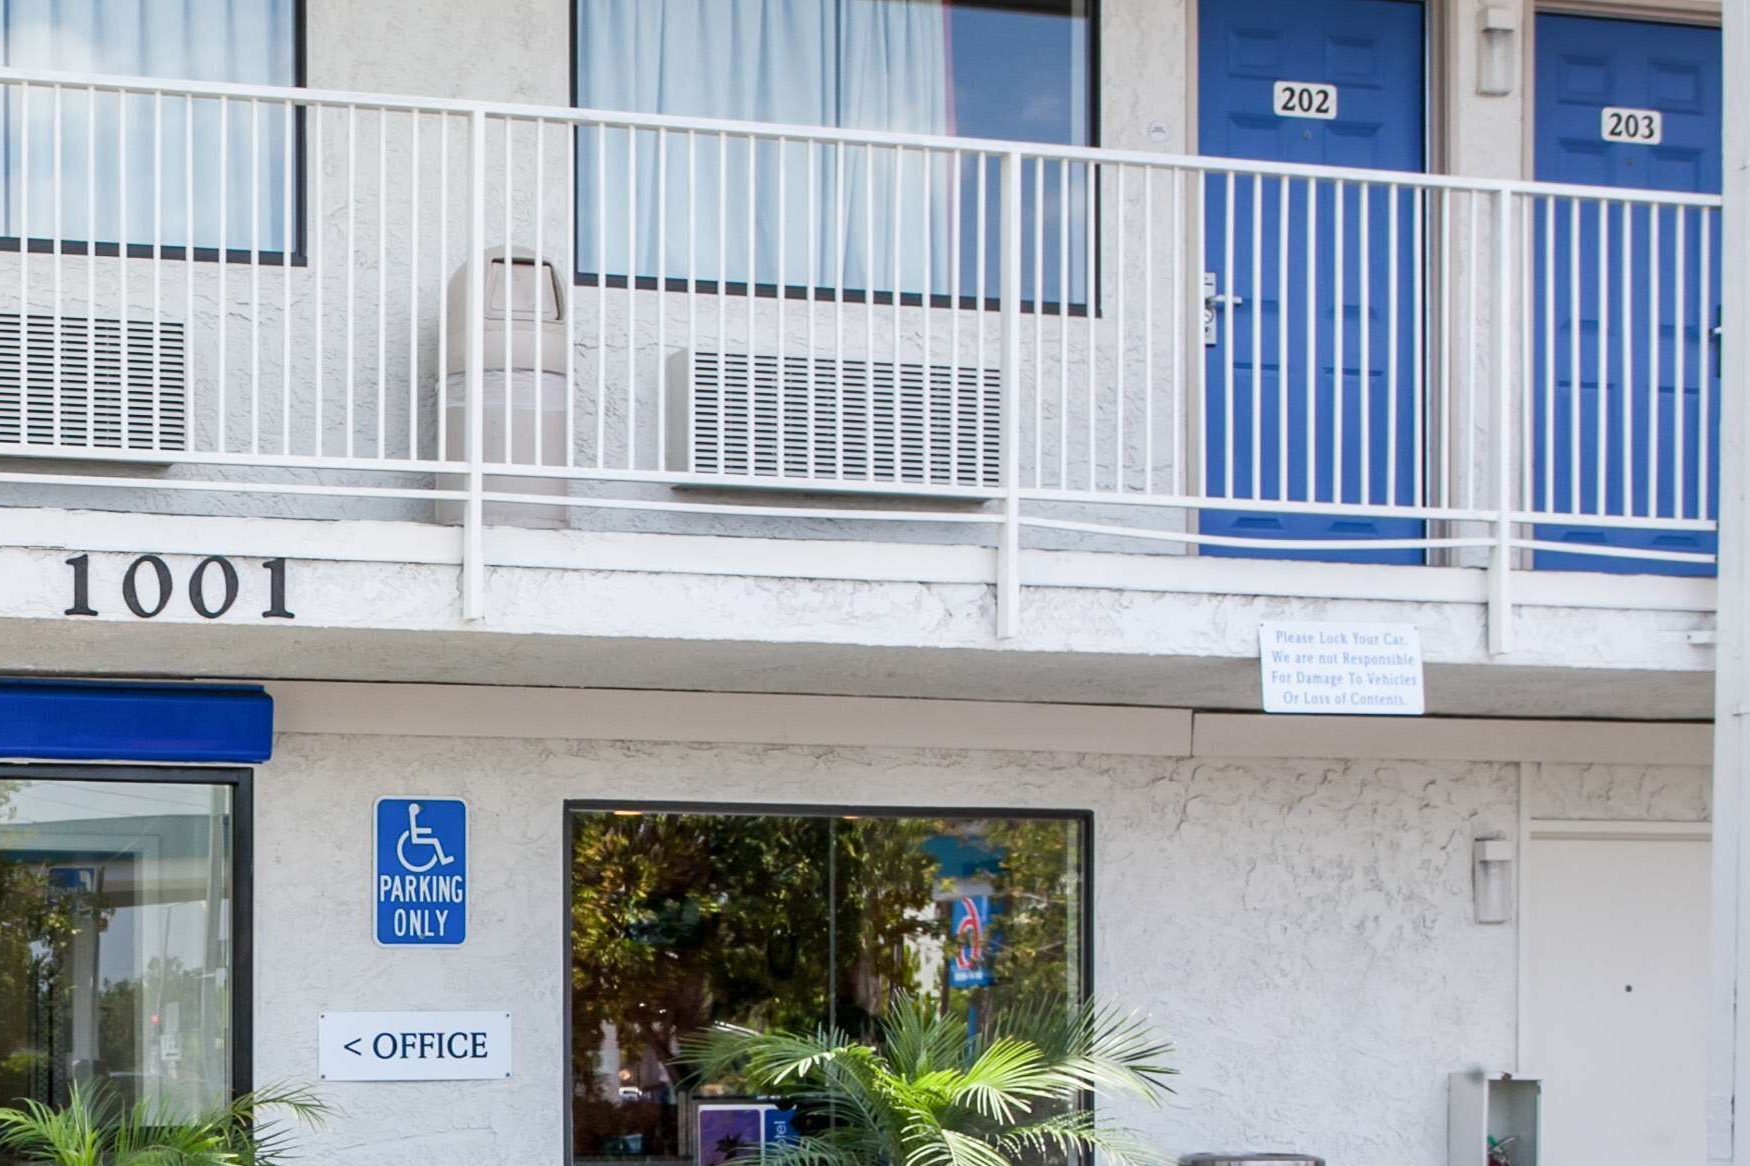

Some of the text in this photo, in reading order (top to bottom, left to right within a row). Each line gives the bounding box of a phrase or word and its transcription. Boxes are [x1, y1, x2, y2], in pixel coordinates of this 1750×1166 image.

[1281, 86, 1330, 114] 202
[1608, 114, 1655, 139] 203
[65, 553, 296, 619] 1001
[1275, 630, 1315, 645] Please
[1319, 631, 1349, 646] Lock
[1352, 632, 1379, 646] Your
[1272, 652, 1414, 668] We are not Responsible
[1271, 671, 1418, 688] For Damage To Vehicles
[1282, 691, 1299, 705] Or
[1303, 692, 1331, 706] Loss
[1334, 692, 1348, 706] of
[380, 874, 464, 903] PARKING
[393, 908, 449, 937] ONLY
[372, 1032, 489, 1059] OFFICE
